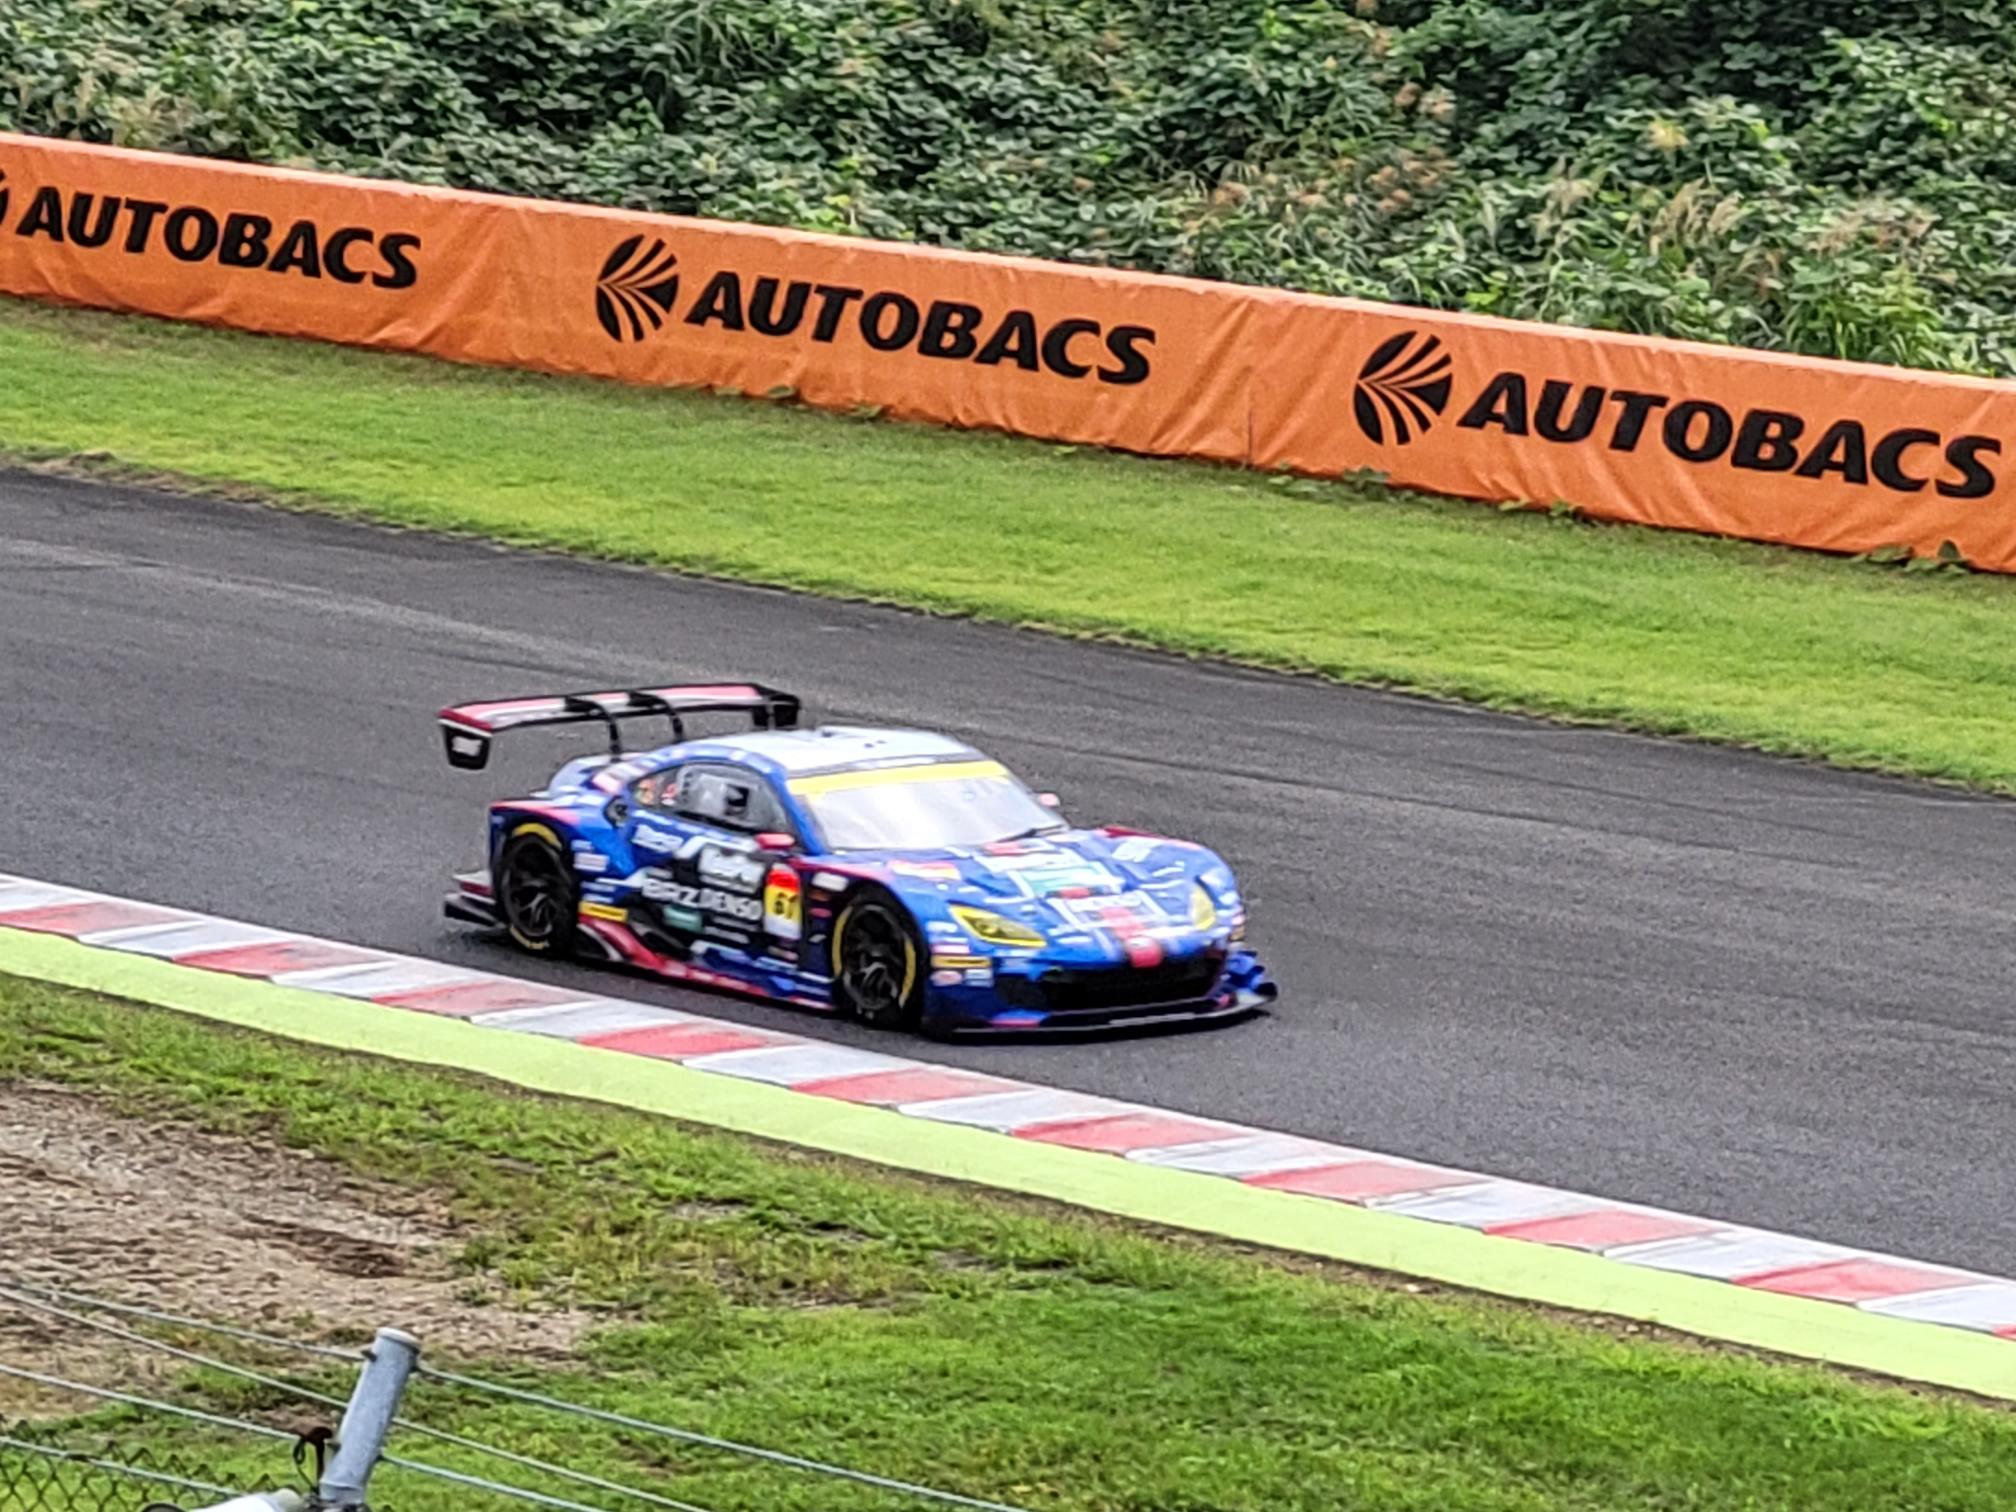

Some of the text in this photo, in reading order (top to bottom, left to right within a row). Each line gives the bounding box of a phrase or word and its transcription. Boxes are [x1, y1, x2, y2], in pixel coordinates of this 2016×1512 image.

[15, 186, 421, 290] AUTOBACS
[684, 270, 1156, 385] AUTOBACS
[1457, 371, 2002, 499] AUTOBACS
[774, 892, 797, 920] 61
